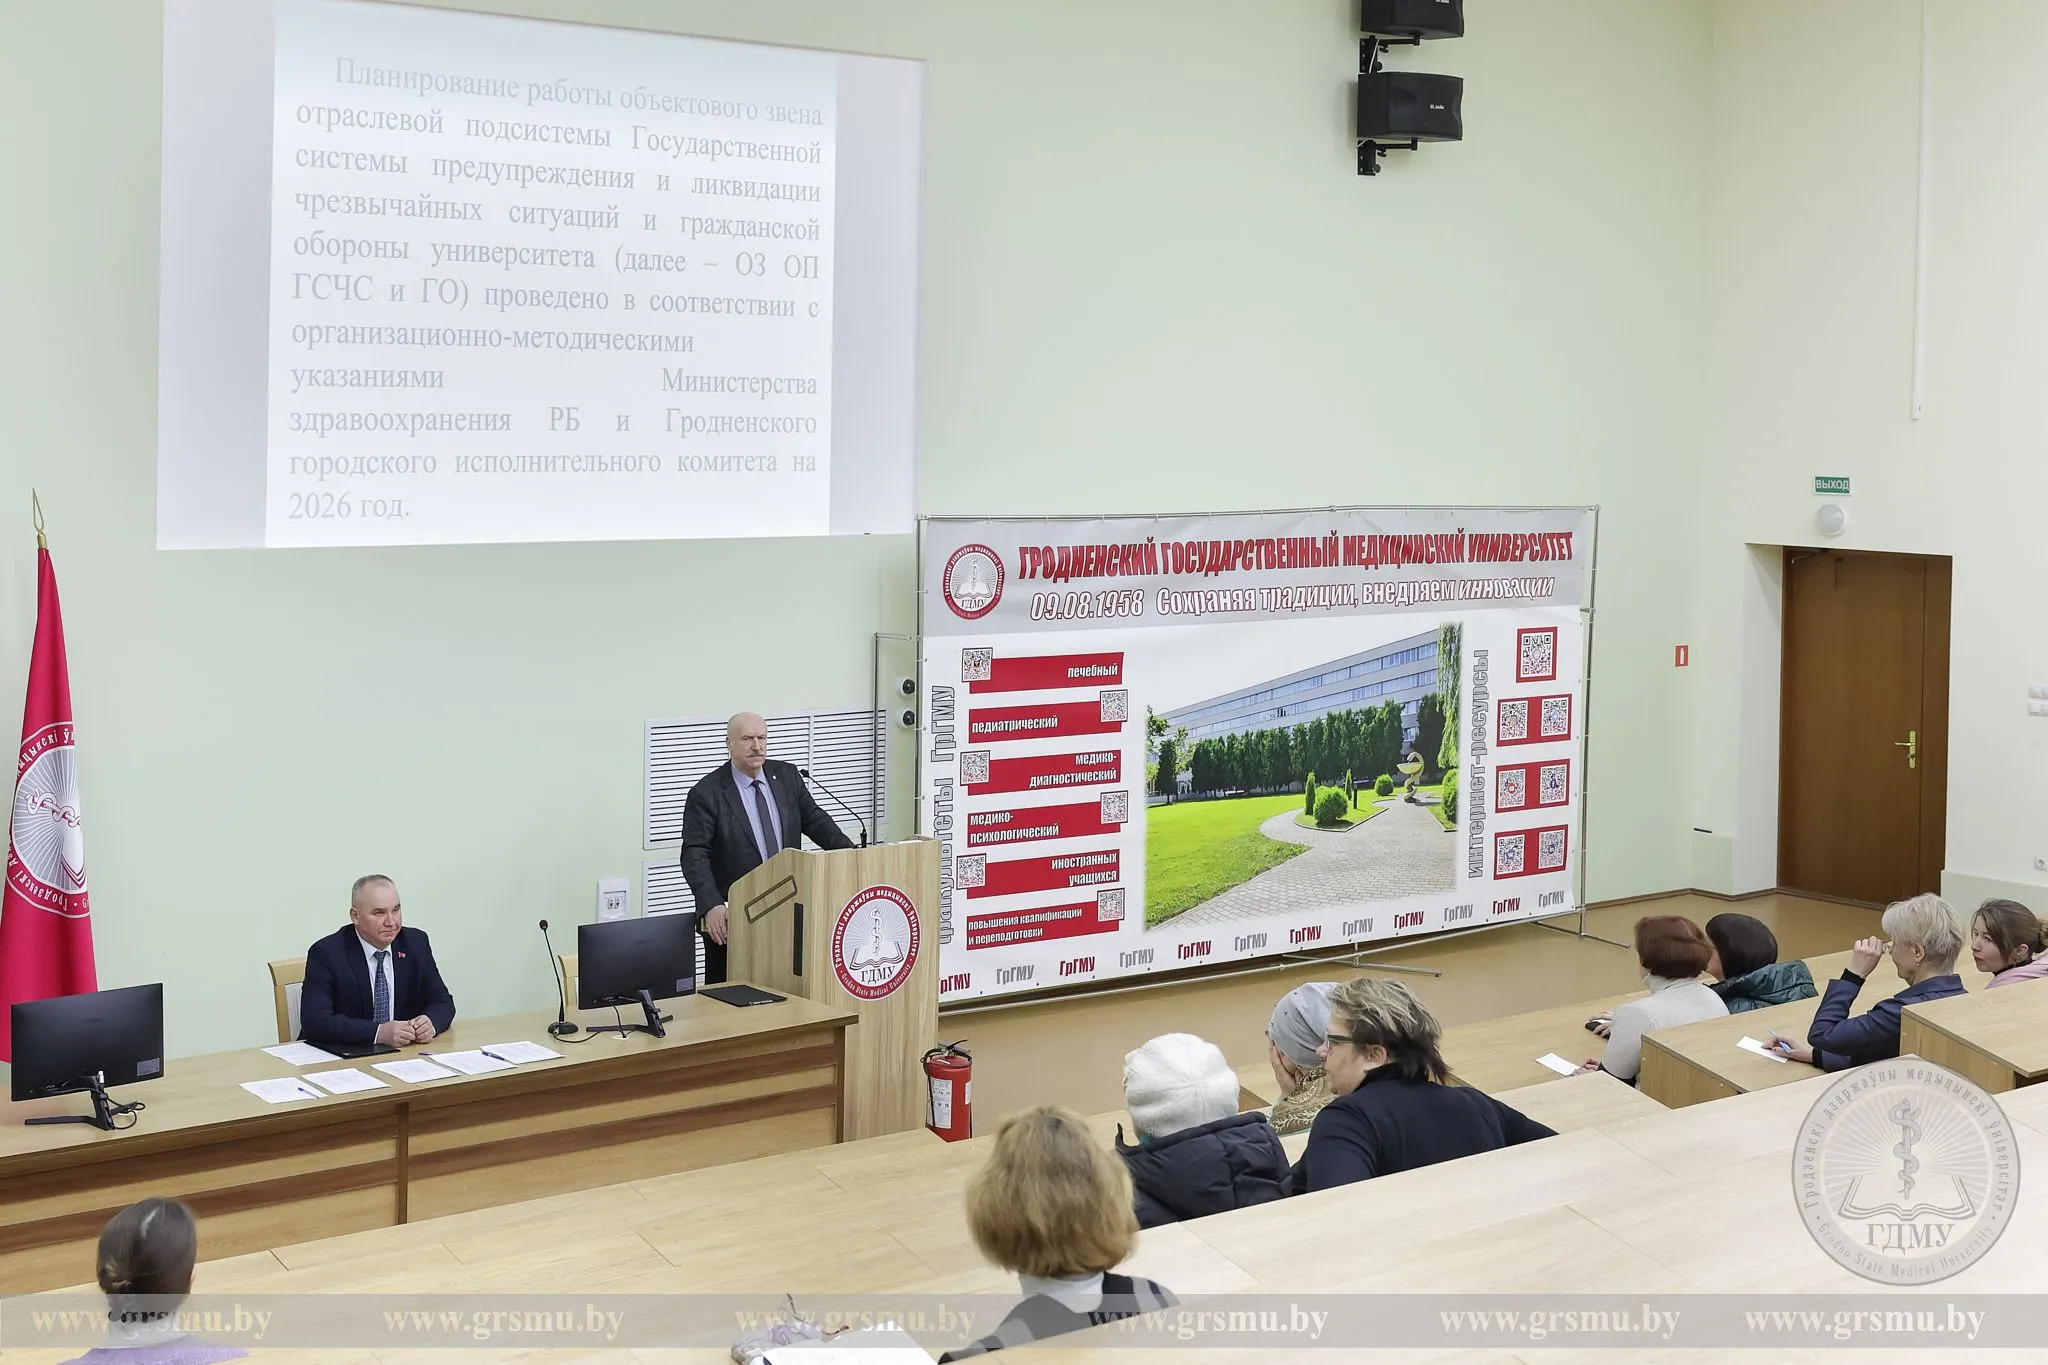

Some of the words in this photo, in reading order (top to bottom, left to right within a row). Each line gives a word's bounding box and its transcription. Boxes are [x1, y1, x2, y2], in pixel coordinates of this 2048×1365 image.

[335, 56, 519, 99] Планирование
[526, 79, 613, 108] работы
[620, 87, 759, 121] объектового
[765, 105, 823, 127] звена
[296, 104, 444, 135] отраслевой
[465, 116, 611, 149] подсистемы
[631, 125, 822, 165] Государственной
[295, 148, 408, 177] системы
[432, 157, 636, 191] предупреждения
[657, 176, 670, 191] и
[692, 176, 822, 204] ликвидации
[294, 191, 484, 223] чрезвычайных
[508, 203, 620, 232] ситуаций
[643, 214, 657, 230] и
[680, 213, 821, 241] гражданской
[293, 230, 410, 264] обороны
[430, 243, 596, 271] университета
[614, 245, 687, 277] (далее
[784, 255, 819, 280] ОП
[292, 272, 374, 302] ГСЧС
[389, 285, 404, 303] и
[420, 277, 469, 310] ГО)
[484, 285, 609, 316] проведено
[623, 295, 636, 311] в
[649, 295, 795, 318] соответствии
[808, 301, 819, 319] с
[291, 321, 694, 355] организационно-методическими
[291, 364, 445, 394] указаниями
[661, 366, 818, 400] Министерства
[290, 410, 511, 439] здравоохранения
[549, 406, 580, 432] РБ
[616, 414, 630, 432] и
[665, 408, 817, 437] Гродненского
[289, 452, 437, 481] городского
[454, 451, 661, 474] исполнительного
[677, 452, 778, 473] комитета
[792, 455, 817, 473] на
[1817, 480, 1849, 491] ВЫХОД
[289, 491, 352, 520] 2026
[360, 496, 411, 523] год.
[1018, 537, 1158, 583] ГРОДНЕНСКИЙ
[1161, 530, 1339, 576] ГОСУДАРСТВЕННЫЙ
[1343, 528, 1465, 570] МЕДИЦИНСКИЙ
[1468, 532, 1573, 563] УНИВЕРСИТЕТ
[1030, 590, 1145, 620] 09.08.1958
[1156, 587, 1256, 615] Сохраняя
[1260, 584, 1359, 612] традиции,
[1362, 580, 1455, 607] внедряем
[1458, 577, 1555, 599] инновации
[1067, 662, 1118, 679] лечебный
[931, 686, 956, 762] ГрГМУ
[972, 715, 1058, 735] педиатрический
[1075, 752, 1117, 765] медико-
[1469, 650, 1489, 878] интернет-ресурсы
[1029, 768, 1117, 788] диагностический
[970, 813, 1014, 826] медико-
[970, 824, 1059, 844] психологический
[1052, 853, 1117, 869] иностранных
[1069, 870, 1117, 887] учащихся
[1492, 897, 1520, 915] ГрГМУ
[1538, 891, 1564, 907] ГрГМУ
[968, 915, 1018, 931] повышения
[1020, 908, 1083, 925] квалификации
[1394, 911, 1424, 929] ГрГМУ
[1444, 904, 1473, 922] ГрГМУ
[968, 936, 974, 945] и
[975, 927, 1043, 945] переподготовки
[1290, 925, 1321, 944] ГрГМУ
[1343, 918, 1373, 936] ГрГМУ
[1178, 941, 1212, 959] ГрГМУ
[1234, 932, 1267, 951] ГрГМУ
[1059, 957, 1095, 976] ГрГМУ
[1119, 949, 1154, 968] ГрГМУ
[861, 966, 895, 984] ГДМУ
[996, 964, 1034, 984] ГрГМУ
